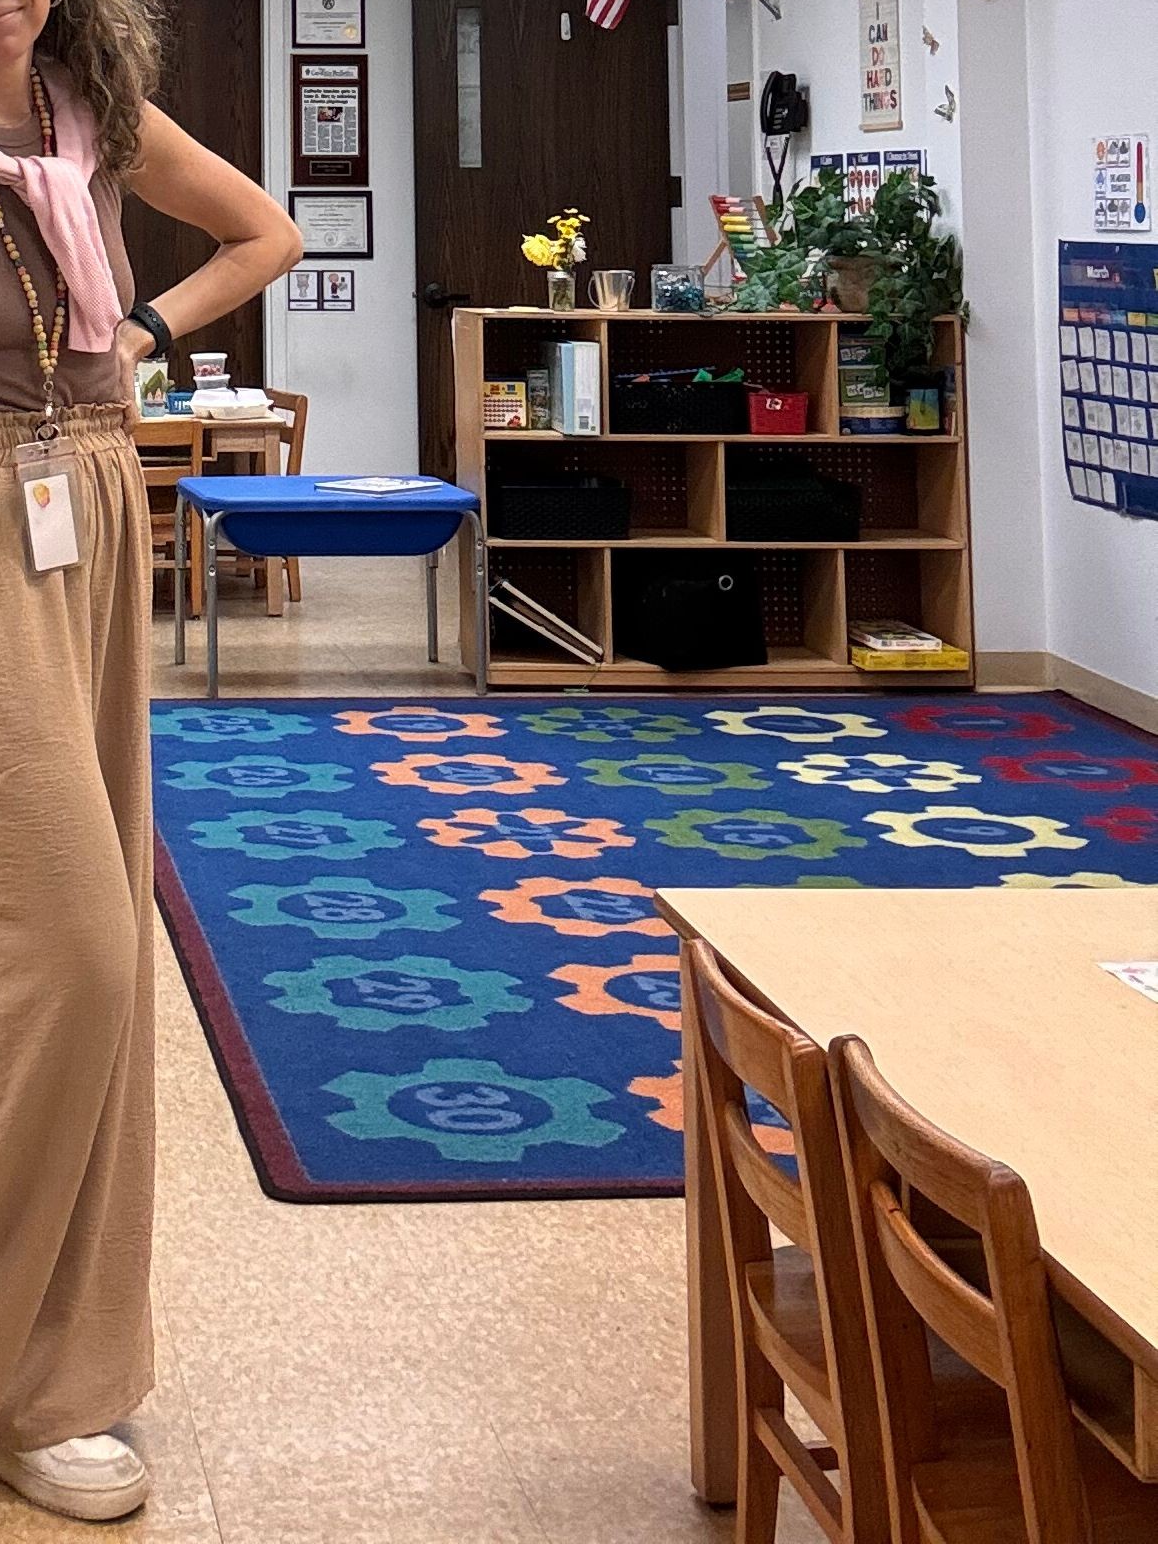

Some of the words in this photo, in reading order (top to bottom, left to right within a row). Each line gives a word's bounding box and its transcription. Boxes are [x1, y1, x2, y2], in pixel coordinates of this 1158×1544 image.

[868, 22, 888, 44] CAN
[871, 46, 885, 66] DO
[866, 67, 892, 89] HARD
[862, 89, 898, 113] THINGS
[199, 716, 257, 733] 25
[385, 715, 447, 731] 19
[227, 766, 293, 786] 26
[435, 765, 503, 782] 20
[634, 765, 711, 782] 14
[1045, 765, 1108, 776] 2
[264, 824, 332, 844] 27
[494, 823, 559, 840] 21
[711, 824, 794, 844] 15
[302, 892, 387, 922] 28
[562, 893, 647, 921] 22
[352, 975, 442, 1009] 29
[415, 1084, 524, 1132] 30
